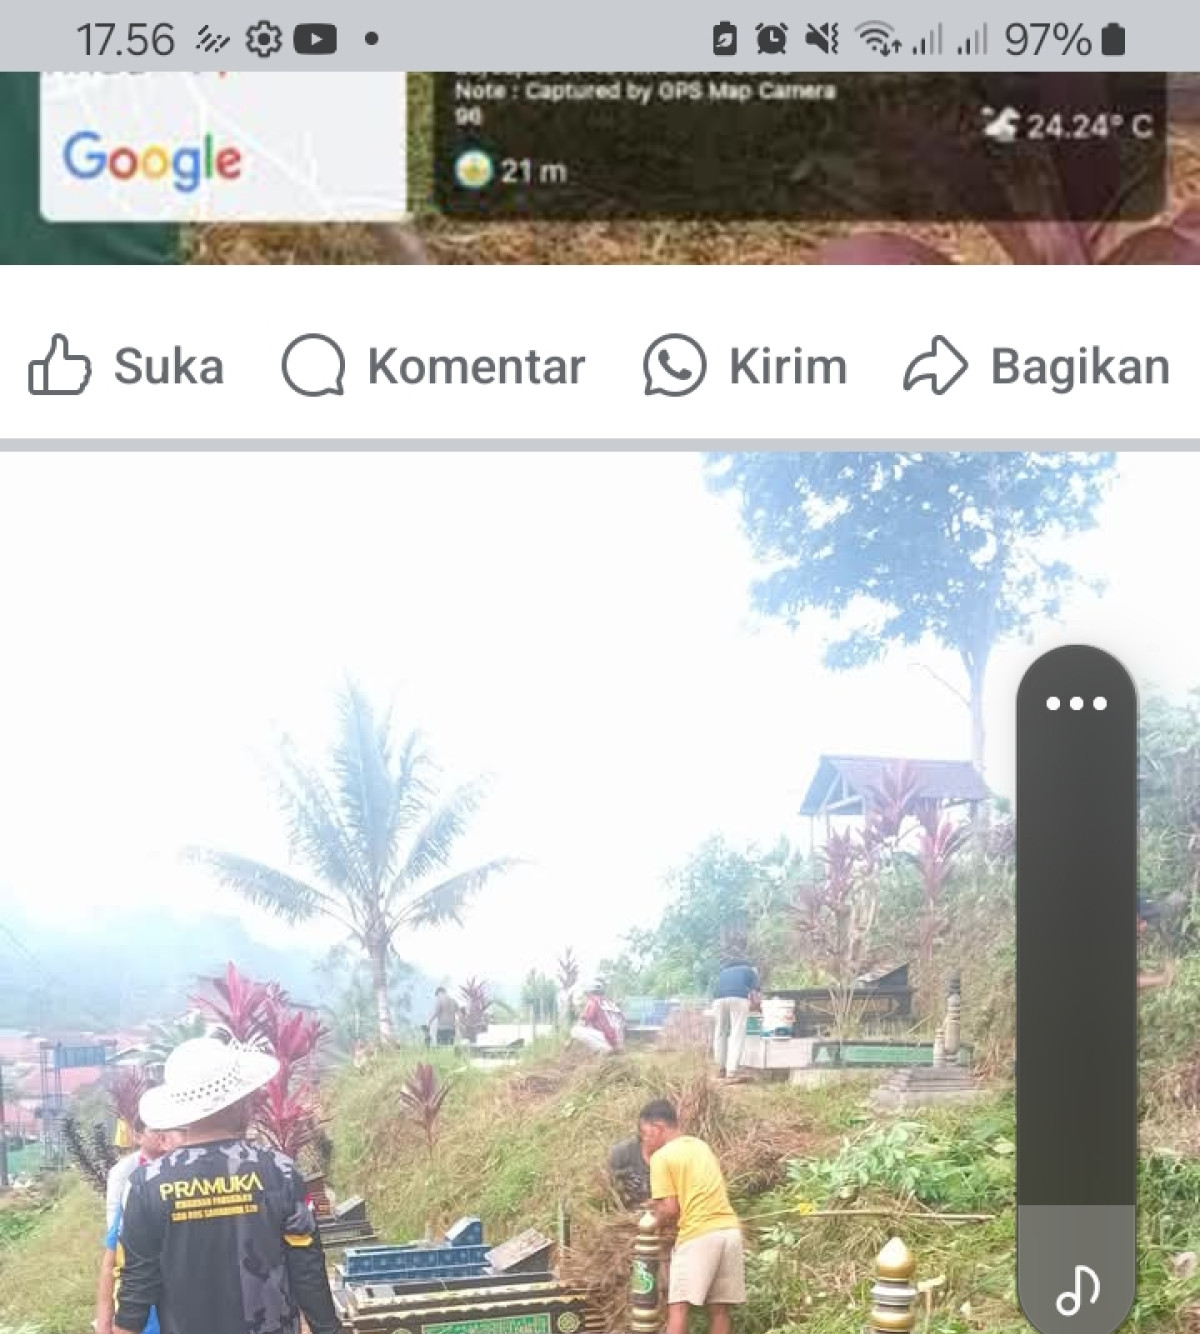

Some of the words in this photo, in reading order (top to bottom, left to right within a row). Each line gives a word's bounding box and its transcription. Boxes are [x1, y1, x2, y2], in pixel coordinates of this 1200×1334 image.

[77, 22, 175, 56] 17.56
[1005, 22, 1093, 56] 97%
[114, 345, 224, 385] Suka
[369, 347, 586, 385] Komentar
[731, 346, 846, 385] Kirim
[992, 345, 1169, 394] Bagikan
[159, 1171, 264, 1201] PRAMUKA
